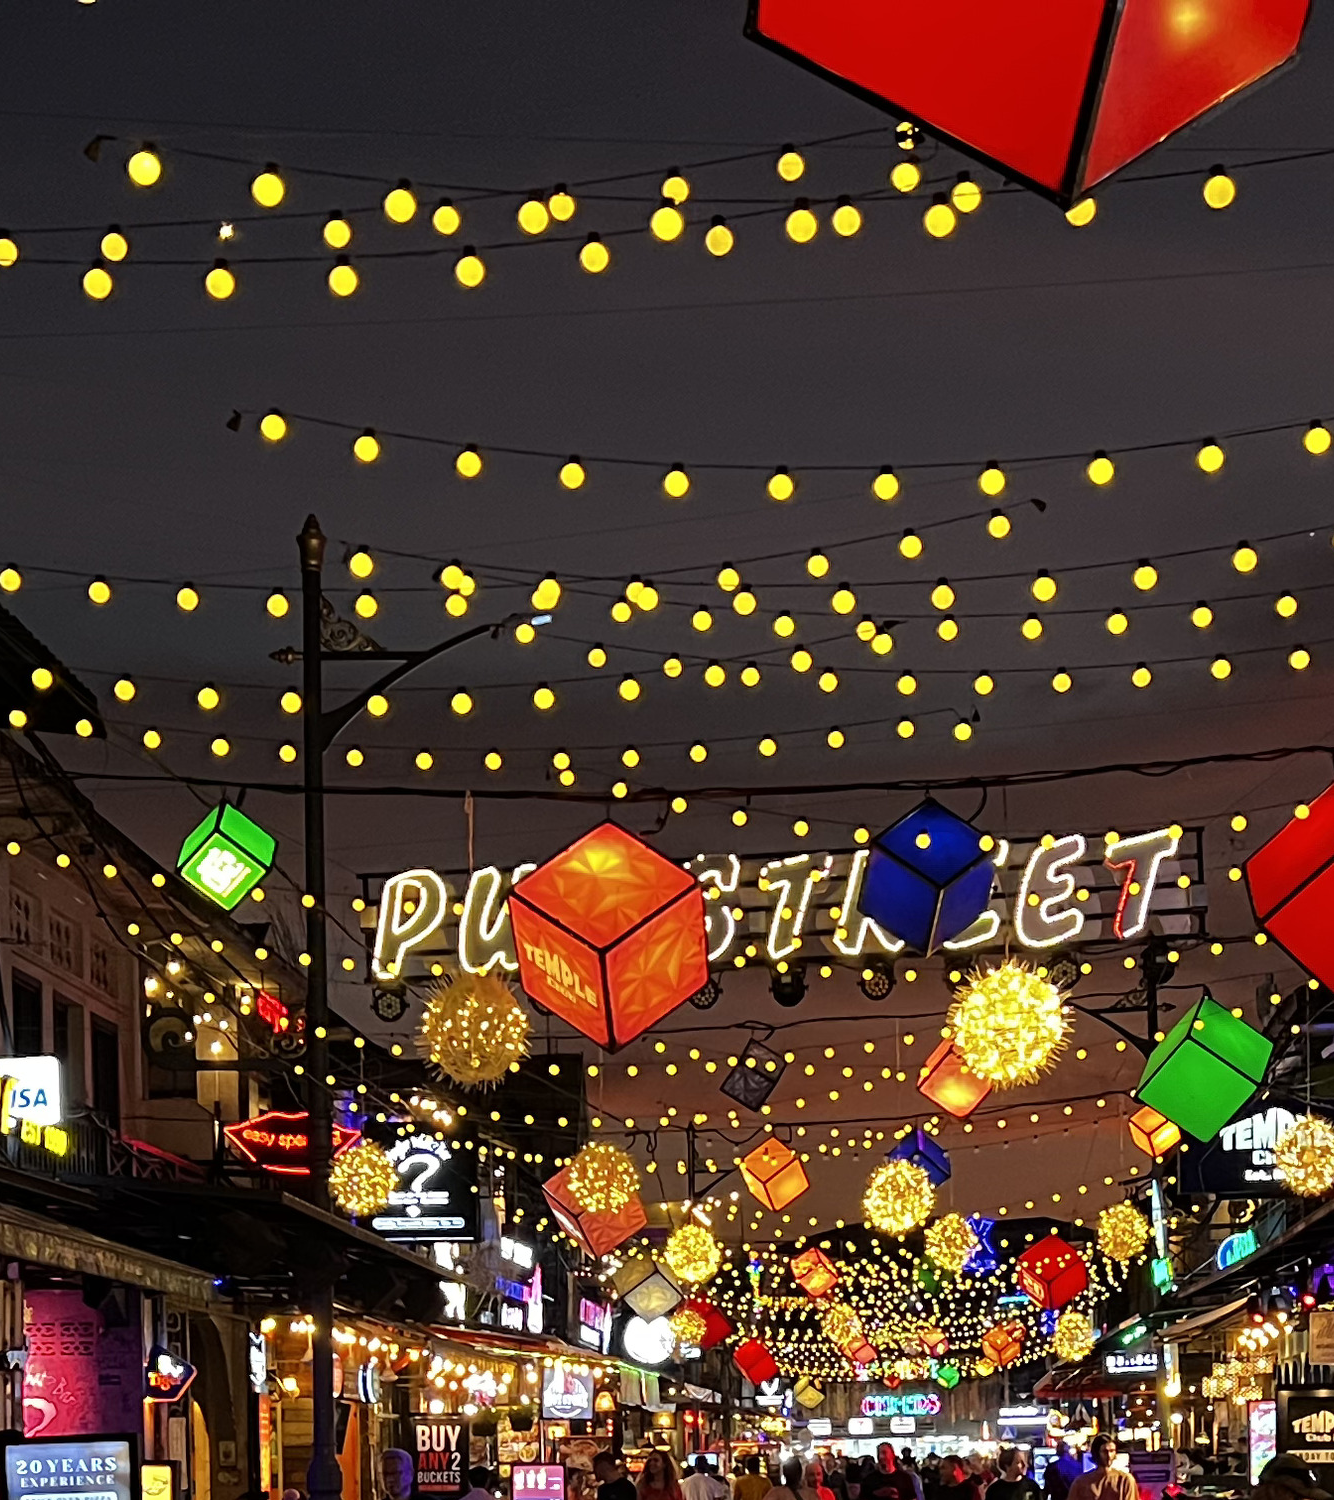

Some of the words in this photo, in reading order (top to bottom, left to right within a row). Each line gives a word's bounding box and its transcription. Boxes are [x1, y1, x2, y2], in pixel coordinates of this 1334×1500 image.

[521, 941, 599, 1008] TEMPLE
[10, 1088, 48, 1108] ISA
[1219, 1106, 1329, 1152] TEMP
[416, 1424, 462, 1452] BUY
[15, 1459, 43, 1475] 20
[46, 1456, 118, 1473] YEARS
[418, 1451, 450, 1471] ANY
[451, 1451, 462, 1471] 2
[20, 1474, 116, 1489] EXPERIENCE
[417, 1471, 462, 1484] BUCKETS
